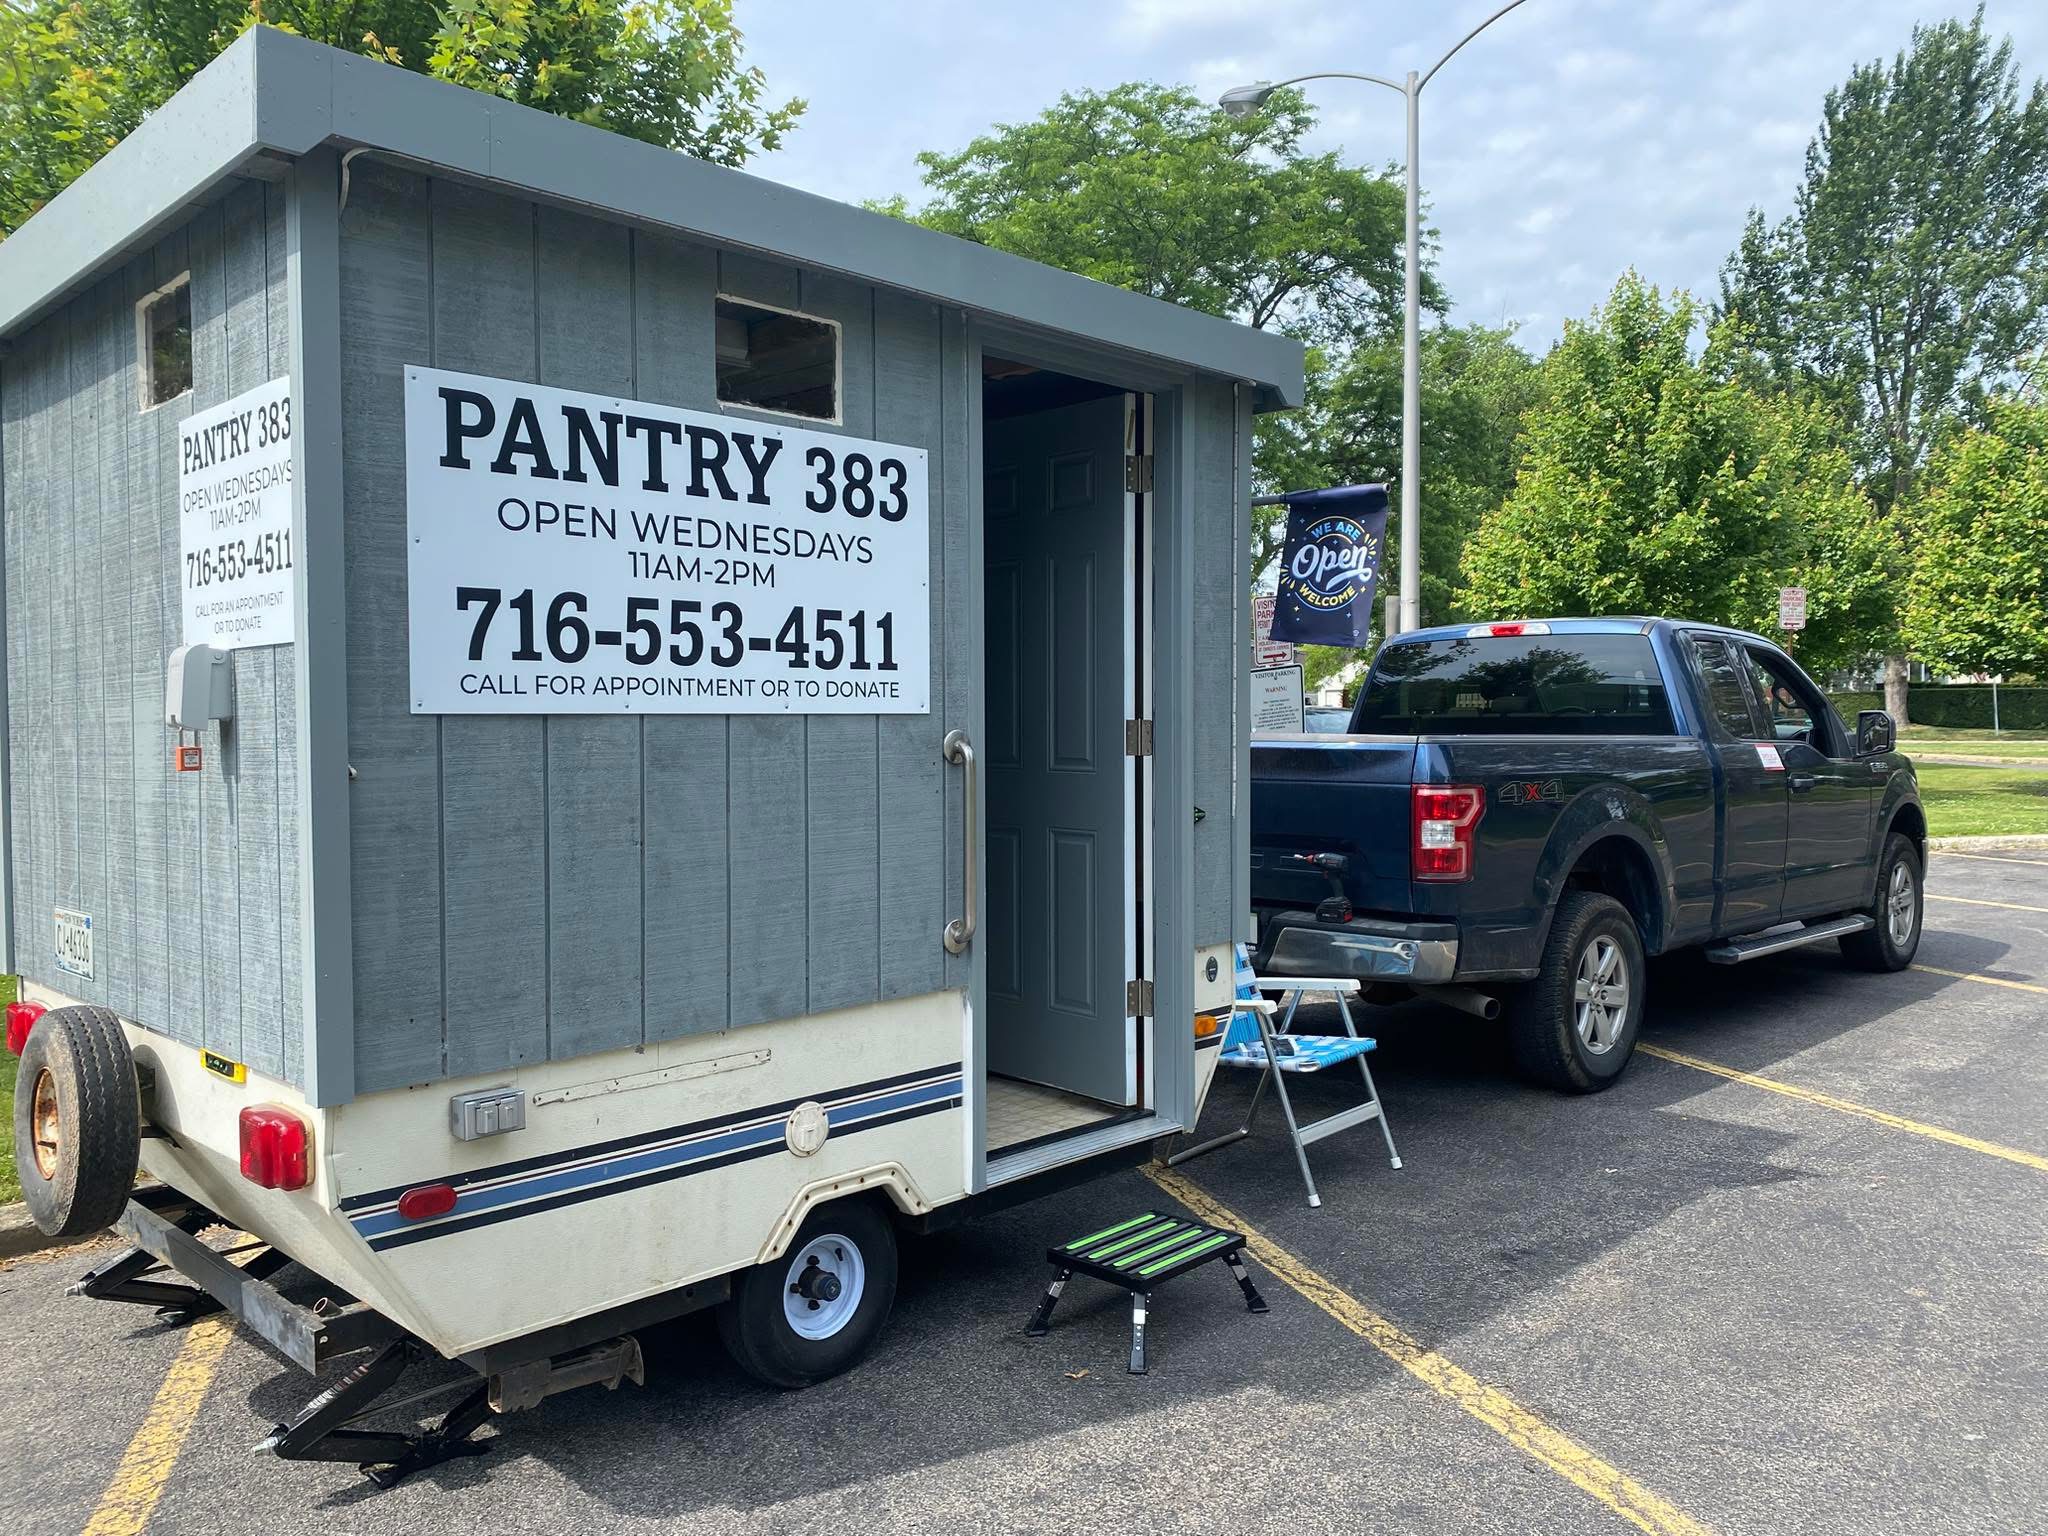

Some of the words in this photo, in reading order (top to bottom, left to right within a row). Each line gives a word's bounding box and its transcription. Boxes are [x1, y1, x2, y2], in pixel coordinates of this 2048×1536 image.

[183, 410, 253, 475] PANTRY
[258, 397, 291, 448] 383
[438, 386, 783, 506] PANTRY
[804, 446, 909, 523] 383
[183, 485, 212, 513] OPEN
[214, 459, 292, 504] WEDNESDAYS
[209, 497, 261, 532] 11AM-2PM
[496, 497, 618, 540] OPEN
[630, 510, 874, 564] WEDNESDAYS
[1310, 521, 1332, 539] WE
[1335, 520, 1361, 541] ARE
[187, 527, 292, 589] 716-553-4511
[627, 551, 776, 588] 11AM-2PM
[1291, 543, 1373, 591] Open
[195, 603, 210, 618] CALL
[211, 601, 225, 616] FOR
[225, 600, 235, 613] AN
[235, 591, 284, 612] APPOINTMENT
[1298, 582, 1356, 607] WELCOME
[214, 621, 224, 634] OR
[225, 620, 235, 633] TO
[235, 615, 262, 633] DONATE
[456, 586, 899, 672] 716-553-4511
[459, 673, 528, 696] CALL
[535, 674, 586, 696] FOR
[593, 676, 754, 698] APPOINTMENT
[760, 679, 789, 698] OR
[796, 680, 821, 698] TO
[826, 680, 900, 699] DONATE
